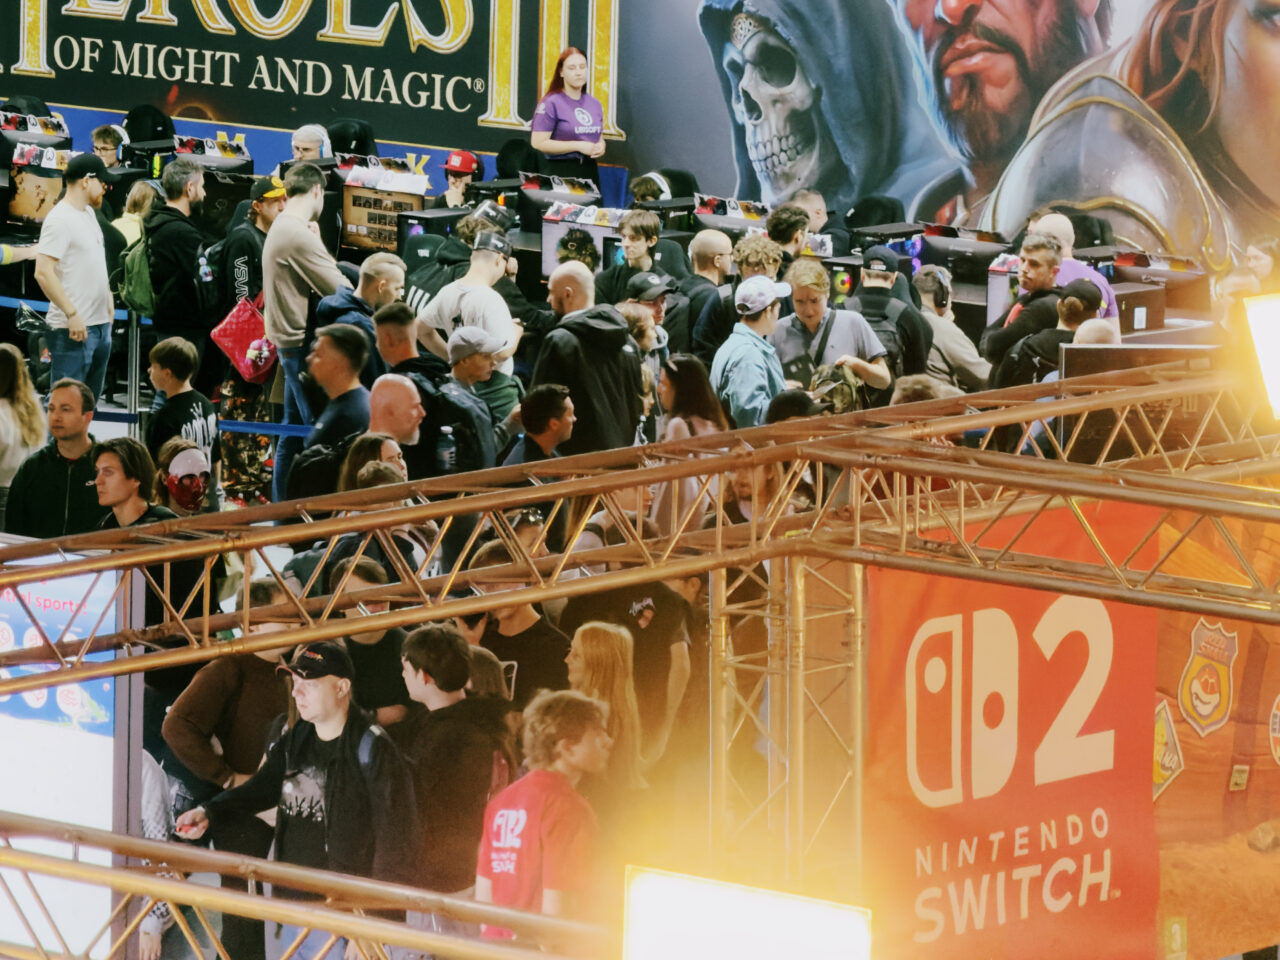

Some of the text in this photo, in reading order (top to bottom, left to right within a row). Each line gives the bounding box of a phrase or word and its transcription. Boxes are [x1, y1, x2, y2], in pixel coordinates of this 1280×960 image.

[53, 34, 102, 73] OF
[111, 39, 240, 87] MIGHT
[248, 55, 333, 97] AND
[574, 126, 601, 134] UBISOFT
[1032, 595, 1115, 786] 2
[915, 808, 1109, 877] NINTENDO
[912, 848, 1111, 944] SWITCH
